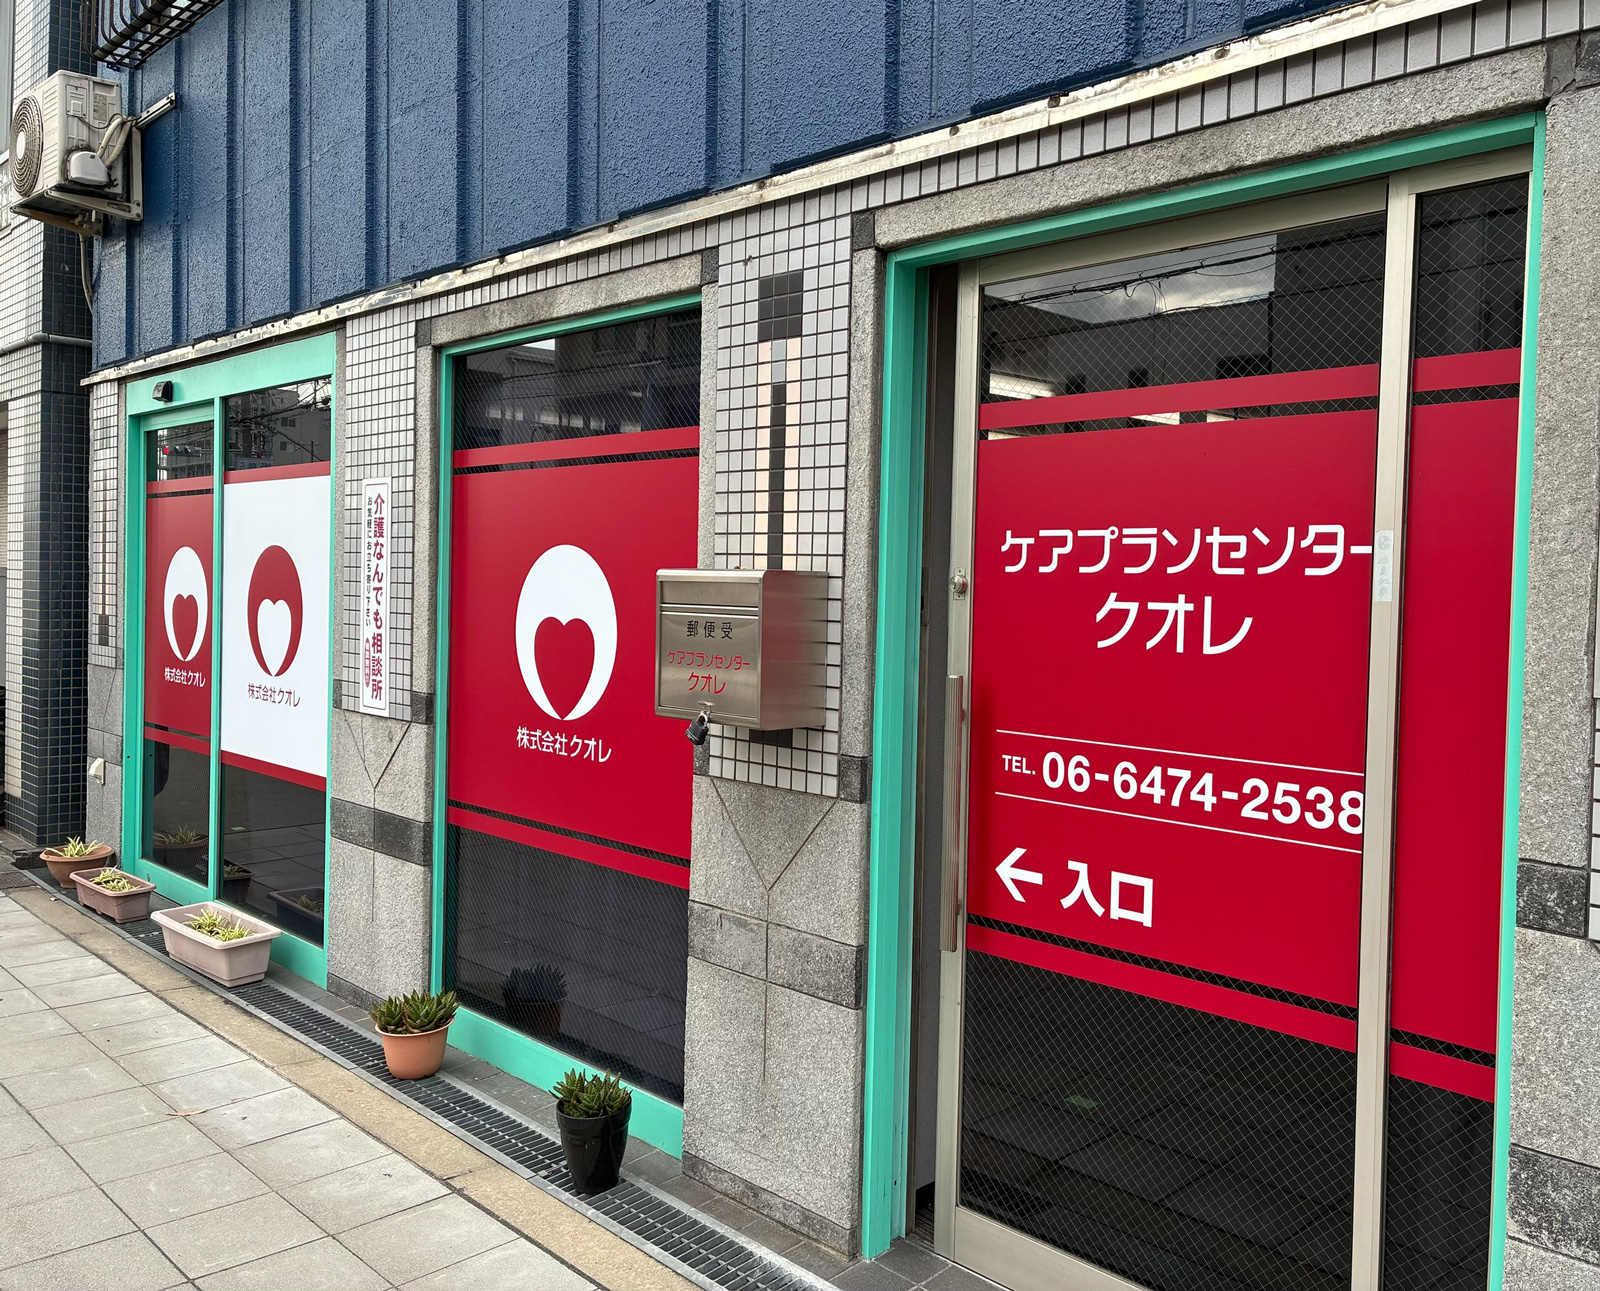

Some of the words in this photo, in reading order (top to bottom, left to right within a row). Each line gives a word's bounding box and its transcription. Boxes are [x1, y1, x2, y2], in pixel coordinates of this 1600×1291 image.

[1001, 525, 1373, 576] ケアプランセンター
[371, 493, 386, 701] 介護なんでも相談所
[686, 620, 733, 640] 郵便受
[1096, 592, 1254, 655] クオレ
[164, 666, 206, 688] 株式会社クオレ
[667, 650, 750, 671] ケアプランセンター
[247, 682, 301, 708] 株式会社クオレ
[687, 671, 727, 695] クオレ
[516, 726, 612, 763] 株式会社クオレ
[1002, 754, 1036, 775] TEL.
[1042, 751, 1363, 835] 06-6474-2538
[1060, 860, 1154, 928] 入口
